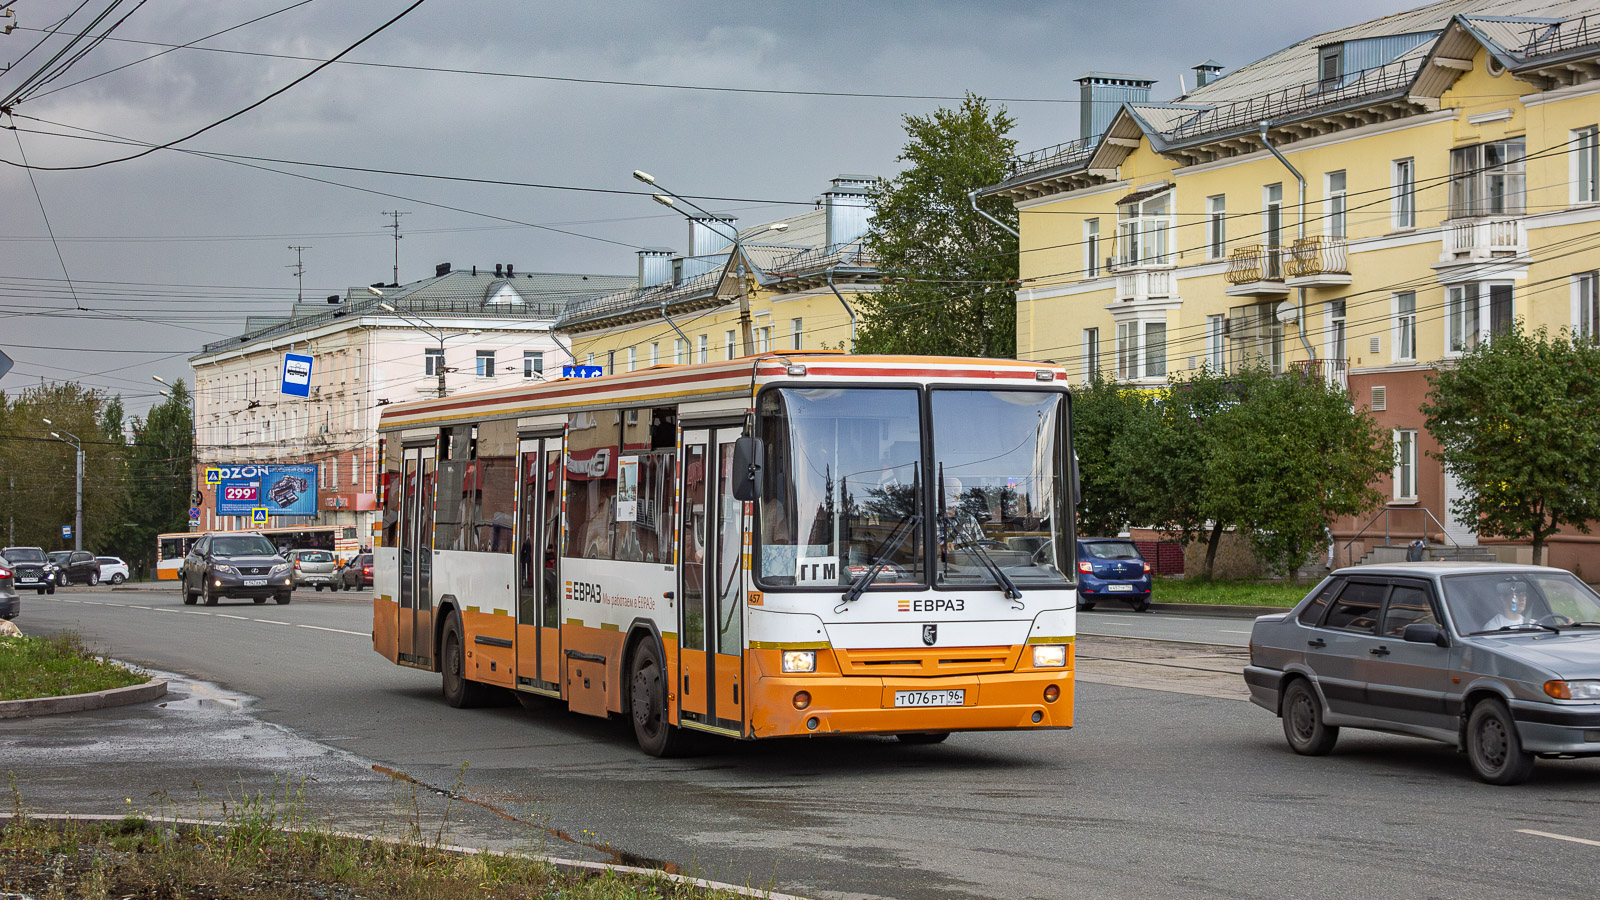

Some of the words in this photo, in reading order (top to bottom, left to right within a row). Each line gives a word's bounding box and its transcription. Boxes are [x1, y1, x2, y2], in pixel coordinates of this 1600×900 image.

[221, 466, 269, 479] OZON
[801, 563, 835, 581] ГГМ
[573, 581, 602, 604] ЕВРАЗ
[602, 593, 611, 605] Мы
[611, 593, 634, 609] работаем
[634, 598, 638, 609] в
[638, 595, 656, 611] ЕВРАЗе
[749, 594, 761, 604] 457
[913, 599, 965, 612] ЕВРАЗ
